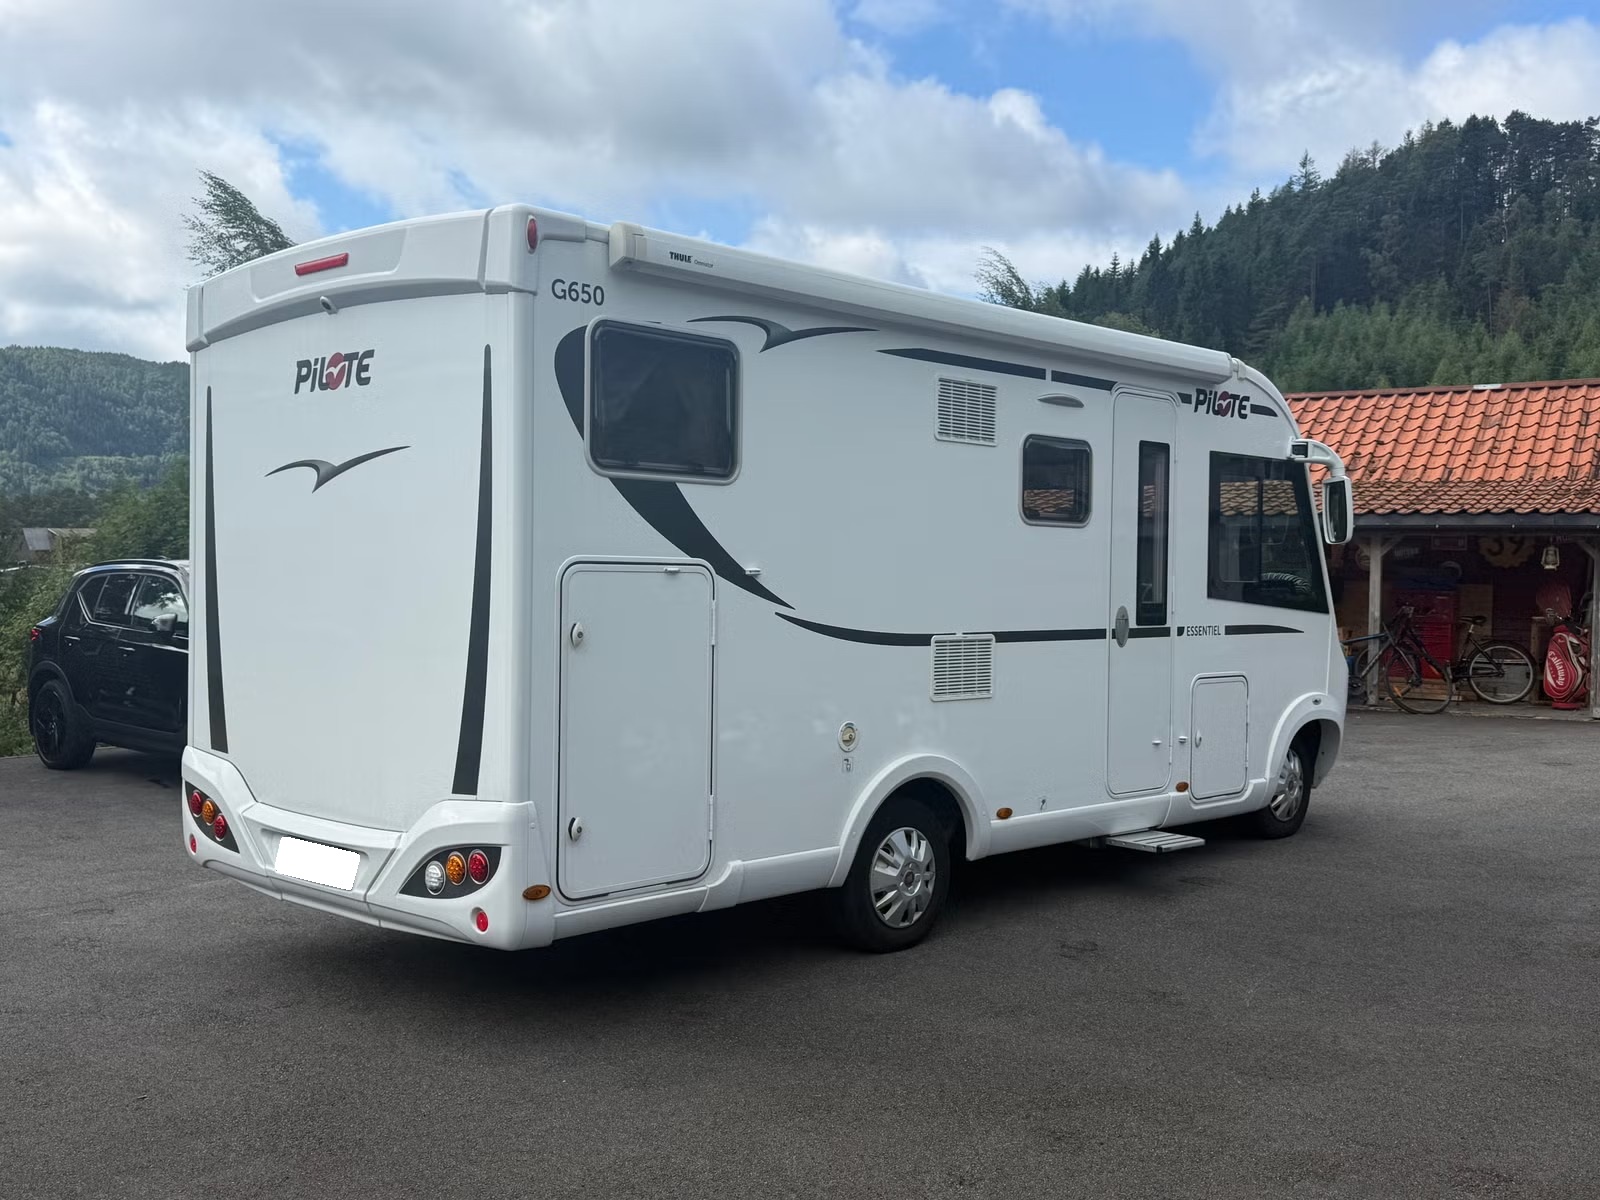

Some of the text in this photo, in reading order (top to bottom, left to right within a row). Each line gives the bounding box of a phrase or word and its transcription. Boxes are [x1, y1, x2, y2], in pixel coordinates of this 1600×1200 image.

[669, 251, 692, 263] THULE
[551, 278, 605, 306] G650
[1186, 625, 1221, 637] ESSENTIEL
[1548, 650, 1566, 686] Callaway
